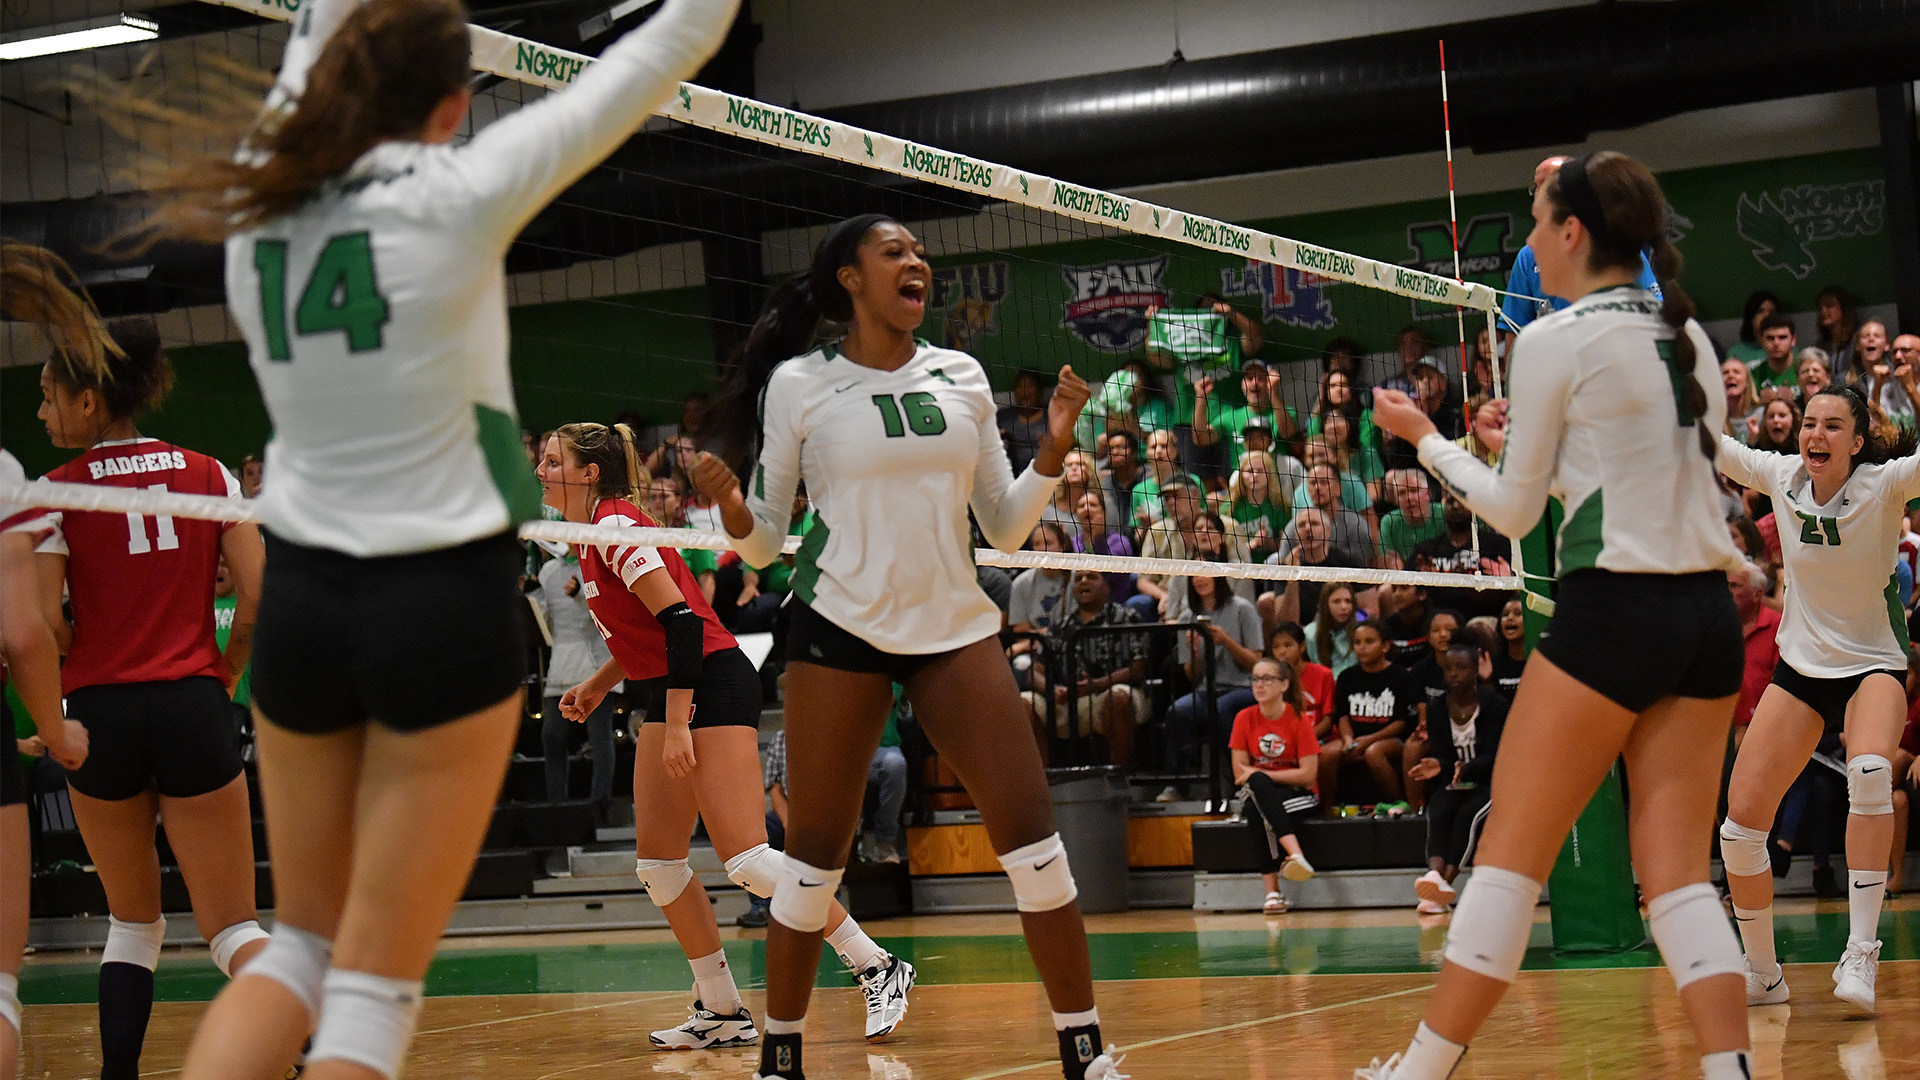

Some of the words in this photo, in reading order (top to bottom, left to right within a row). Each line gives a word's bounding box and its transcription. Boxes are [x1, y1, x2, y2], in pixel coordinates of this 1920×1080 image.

[726, 97, 782, 135] NORTH
[783, 112, 831, 148] TEXAS
[902, 144, 950, 179] NORTH
[952, 156, 992, 188] TEXAS
[1052, 182, 1095, 212] NORTH
[1094, 193, 1131, 222] TEXAS
[1780, 180, 1885, 219] NORTH
[1182, 215, 1220, 244] NORTH
[1217, 225, 1250, 251] TEXAS
[1295, 244, 1327, 269] NORTH
[1326, 251, 1355, 276] TEXAS
[255, 231, 392, 363] 14
[931, 263, 1007, 308] FIU
[1395, 269, 1422, 291] NORTH
[1421, 276, 1449, 298] TEXAS
[872, 392, 947, 437] 16
[88, 451, 187, 480] BADGERS
[126, 483, 180, 555] 11
[1795, 510, 1841, 546] 21
